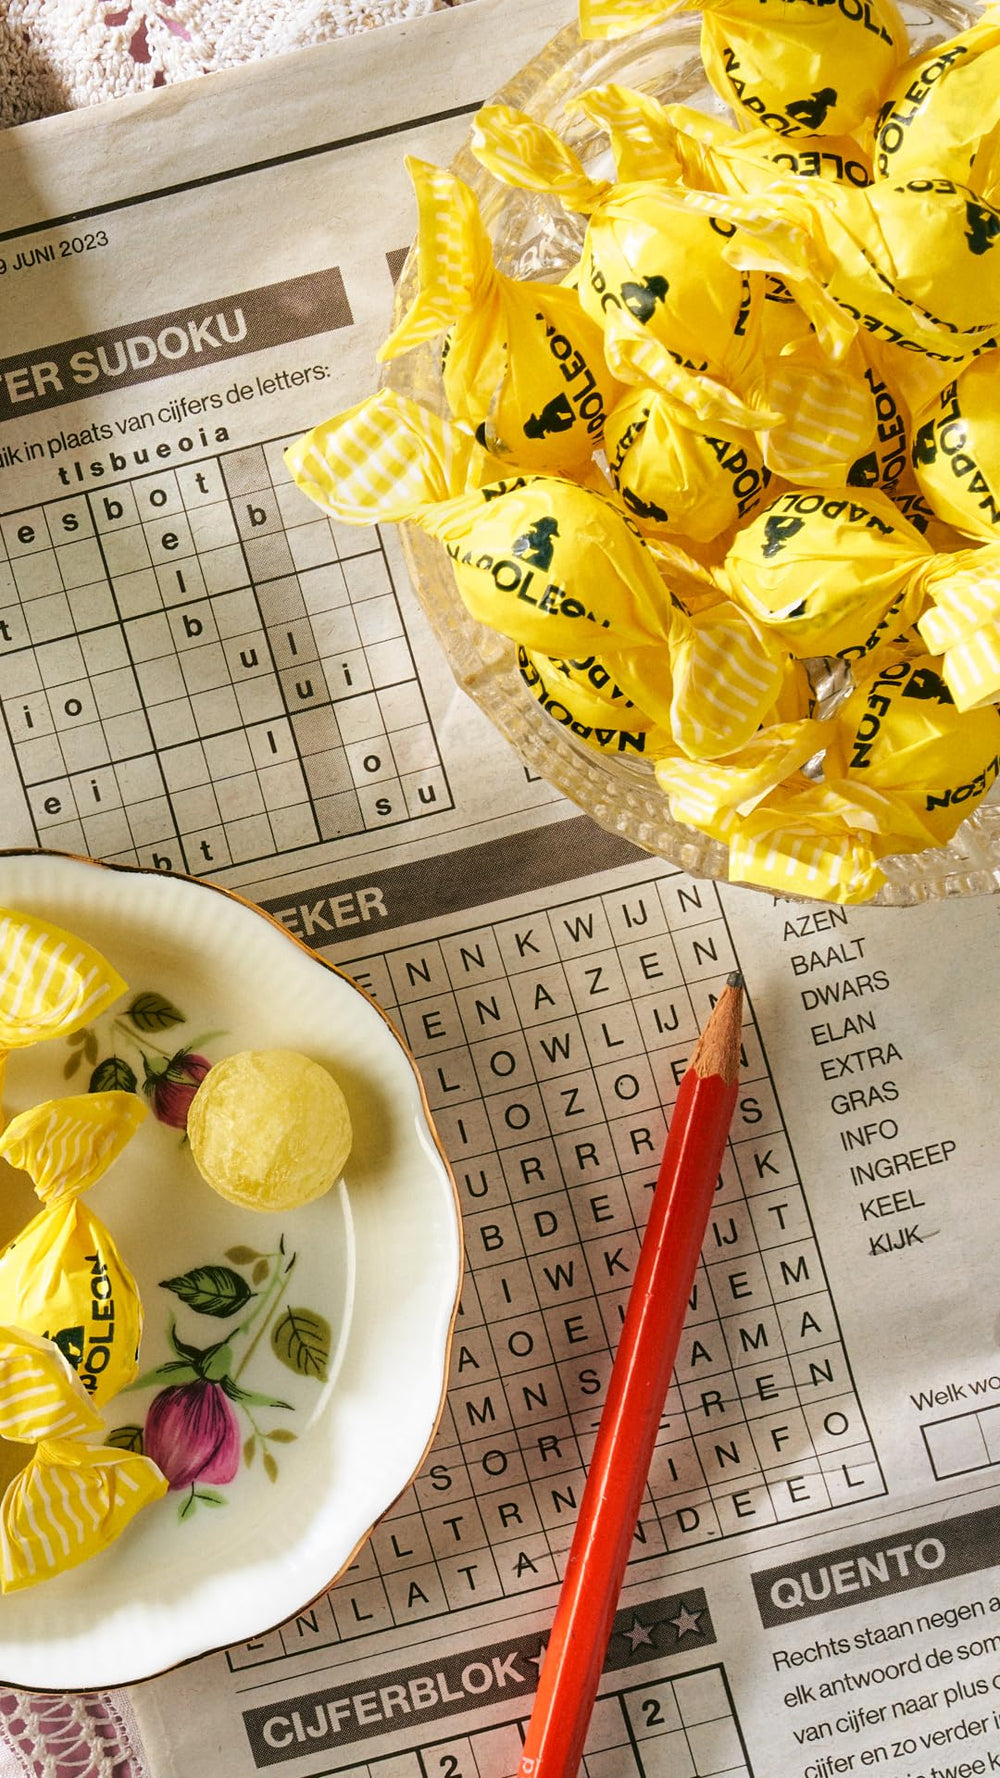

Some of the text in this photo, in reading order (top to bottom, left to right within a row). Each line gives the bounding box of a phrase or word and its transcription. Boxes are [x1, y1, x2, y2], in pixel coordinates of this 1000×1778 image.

[13, 245, 56, 271] JUNI
[59, 231, 109, 257] 2023
[0, 308, 249, 404] ER SUDOKU
[24, 363, 331, 461] in plaats van cijfers de letters:
[783, 907, 848, 941] AZEN
[791, 938, 866, 976] BAALT
[801, 970, 890, 1011] DWARS
[811, 1011, 876, 1046] ELAN
[820, 1043, 903, 1080] EXTRA
[831, 1081, 899, 1115] GRAS
[840, 1119, 898, 1151] INFO
[850, 1140, 956, 1186] INGREEP
[860, 1189, 925, 1221] KEEL
[869, 1225, 923, 1256] KIJK
[910, 1384, 967, 1411] Welk
[770, 1538, 946, 1610] QUENTO
[772, 1601, 986, 1672] Rechts staan negen
[784, 1685, 817, 1708] elk
[819, 1653, 922, 1699] antwoord
[925, 1648, 954, 1669] de
[262, 1651, 526, 1749] CIJFERBLOK
[642, 1698, 665, 1727] 2
[793, 1722, 833, 1744] van
[836, 1706, 887, 1733] cijfer
[892, 1692, 939, 1719] naar
[944, 1679, 989, 1708] plus
[861, 1747, 888, 1766] en
[891, 1739, 917, 1758] zo
[919, 1718, 989, 1748] verder
